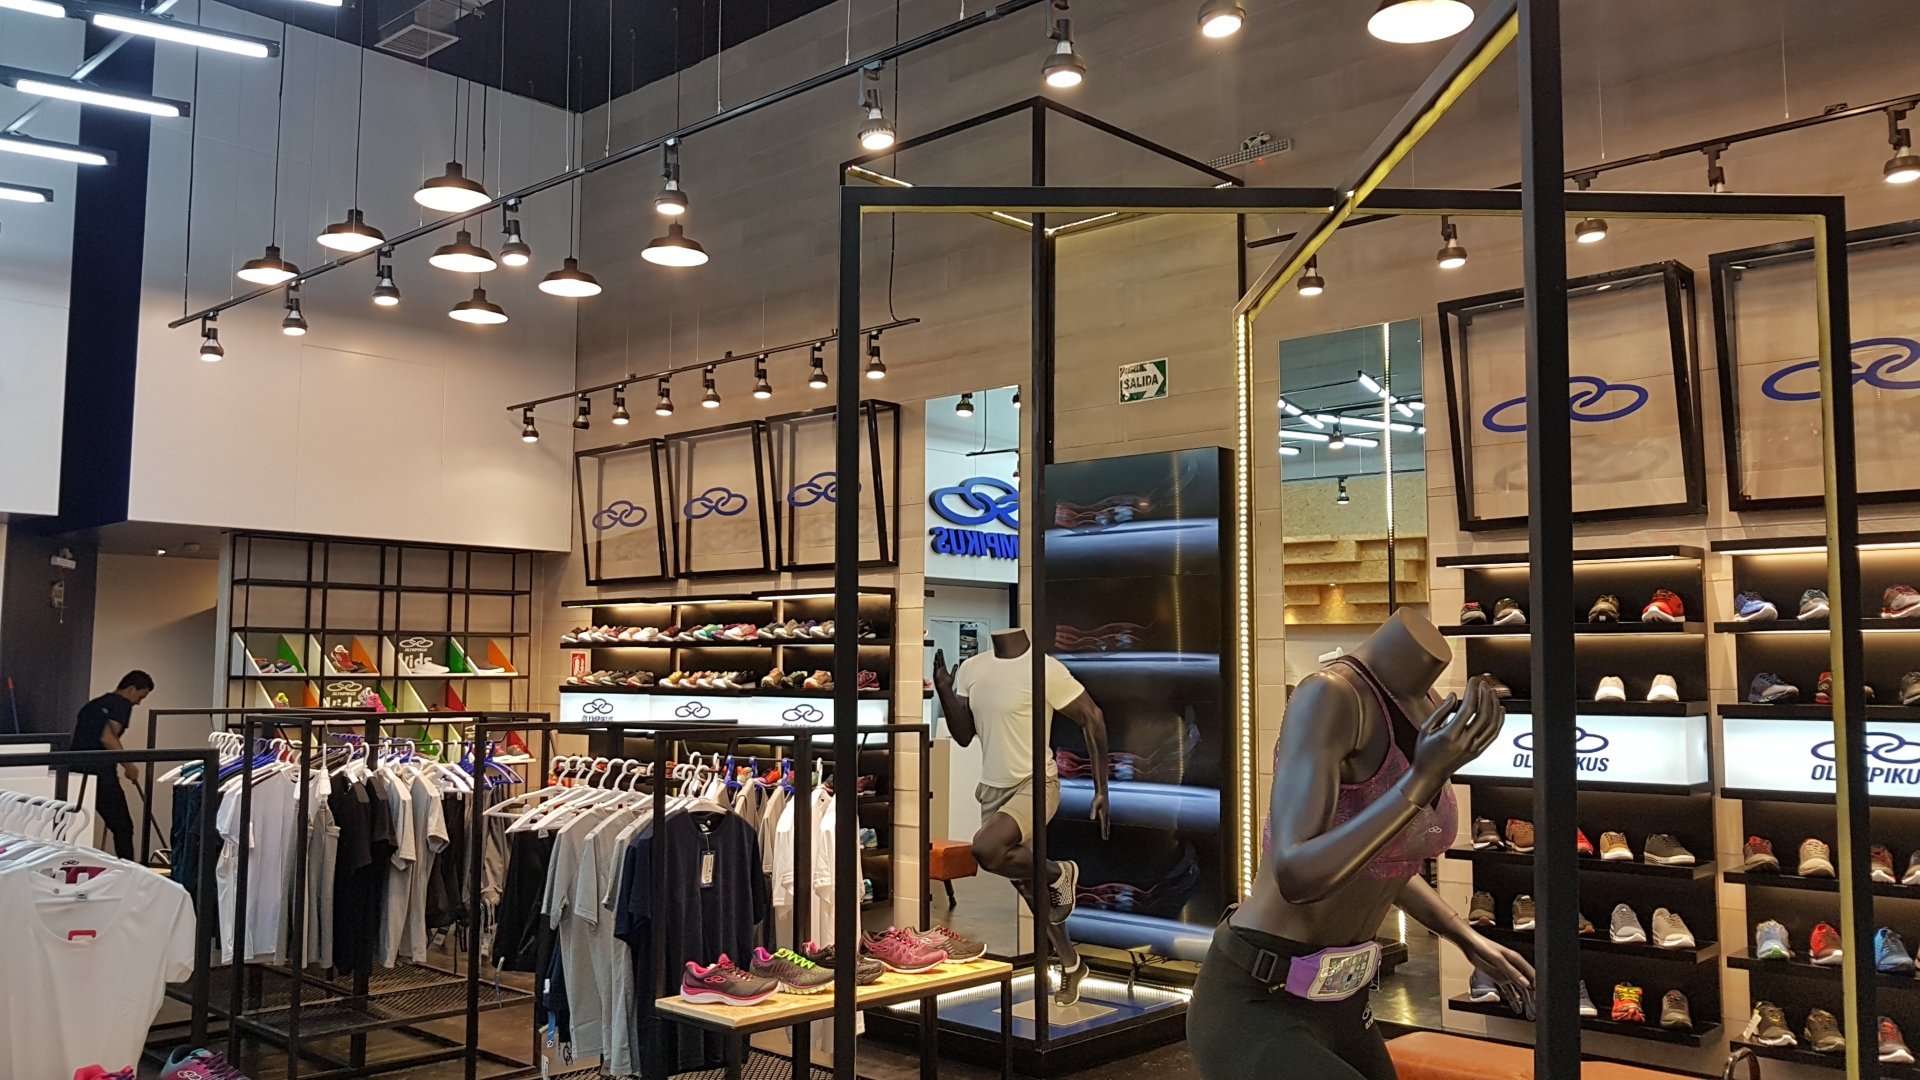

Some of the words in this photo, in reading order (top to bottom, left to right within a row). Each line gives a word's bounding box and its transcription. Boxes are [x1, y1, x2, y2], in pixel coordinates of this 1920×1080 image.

[1123, 374, 1159, 390] SALIDA
[1512, 753, 1609, 772] OLKUS
[1811, 764, 1920, 785] OLPIKU
